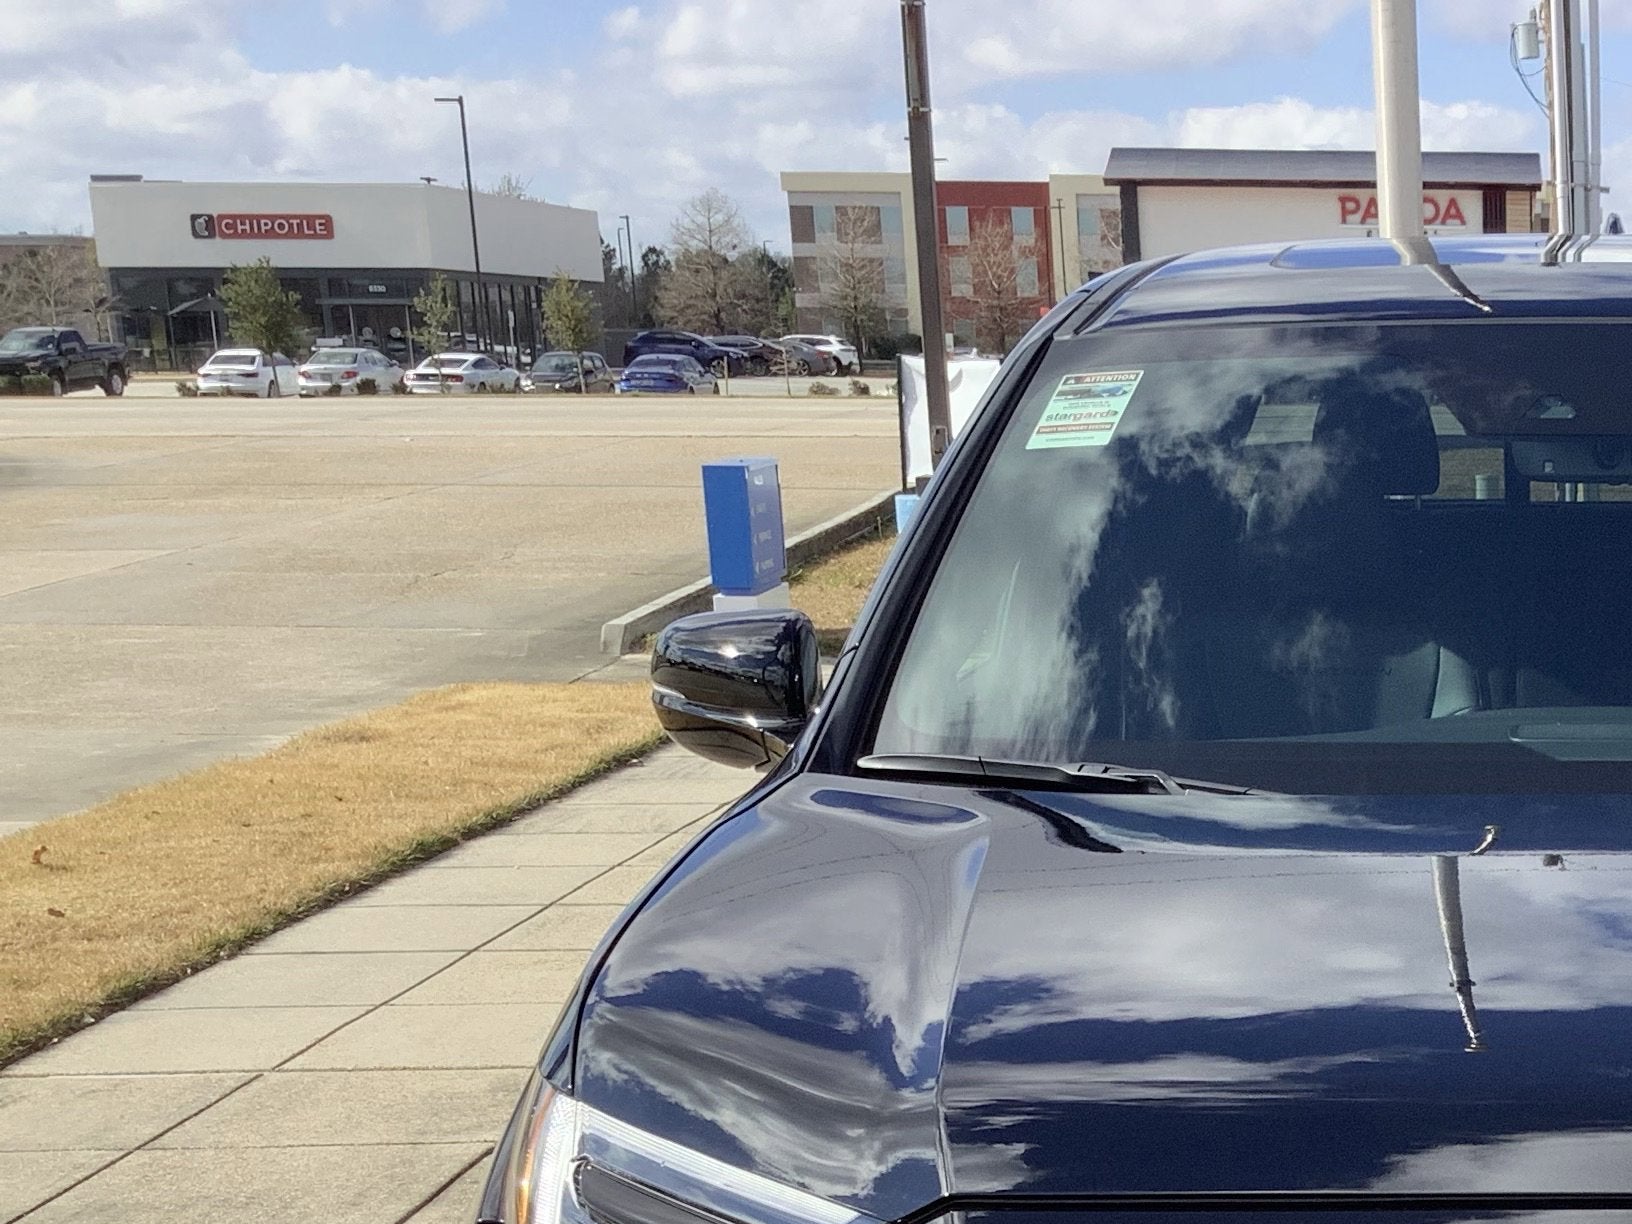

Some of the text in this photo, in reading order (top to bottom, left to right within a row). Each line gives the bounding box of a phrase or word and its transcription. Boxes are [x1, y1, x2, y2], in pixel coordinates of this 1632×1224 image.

[1338, 195, 1466, 225] PADA
[221, 219, 328, 234] CHIPOTLE
[1083, 373, 1137, 384] ATTENTION
